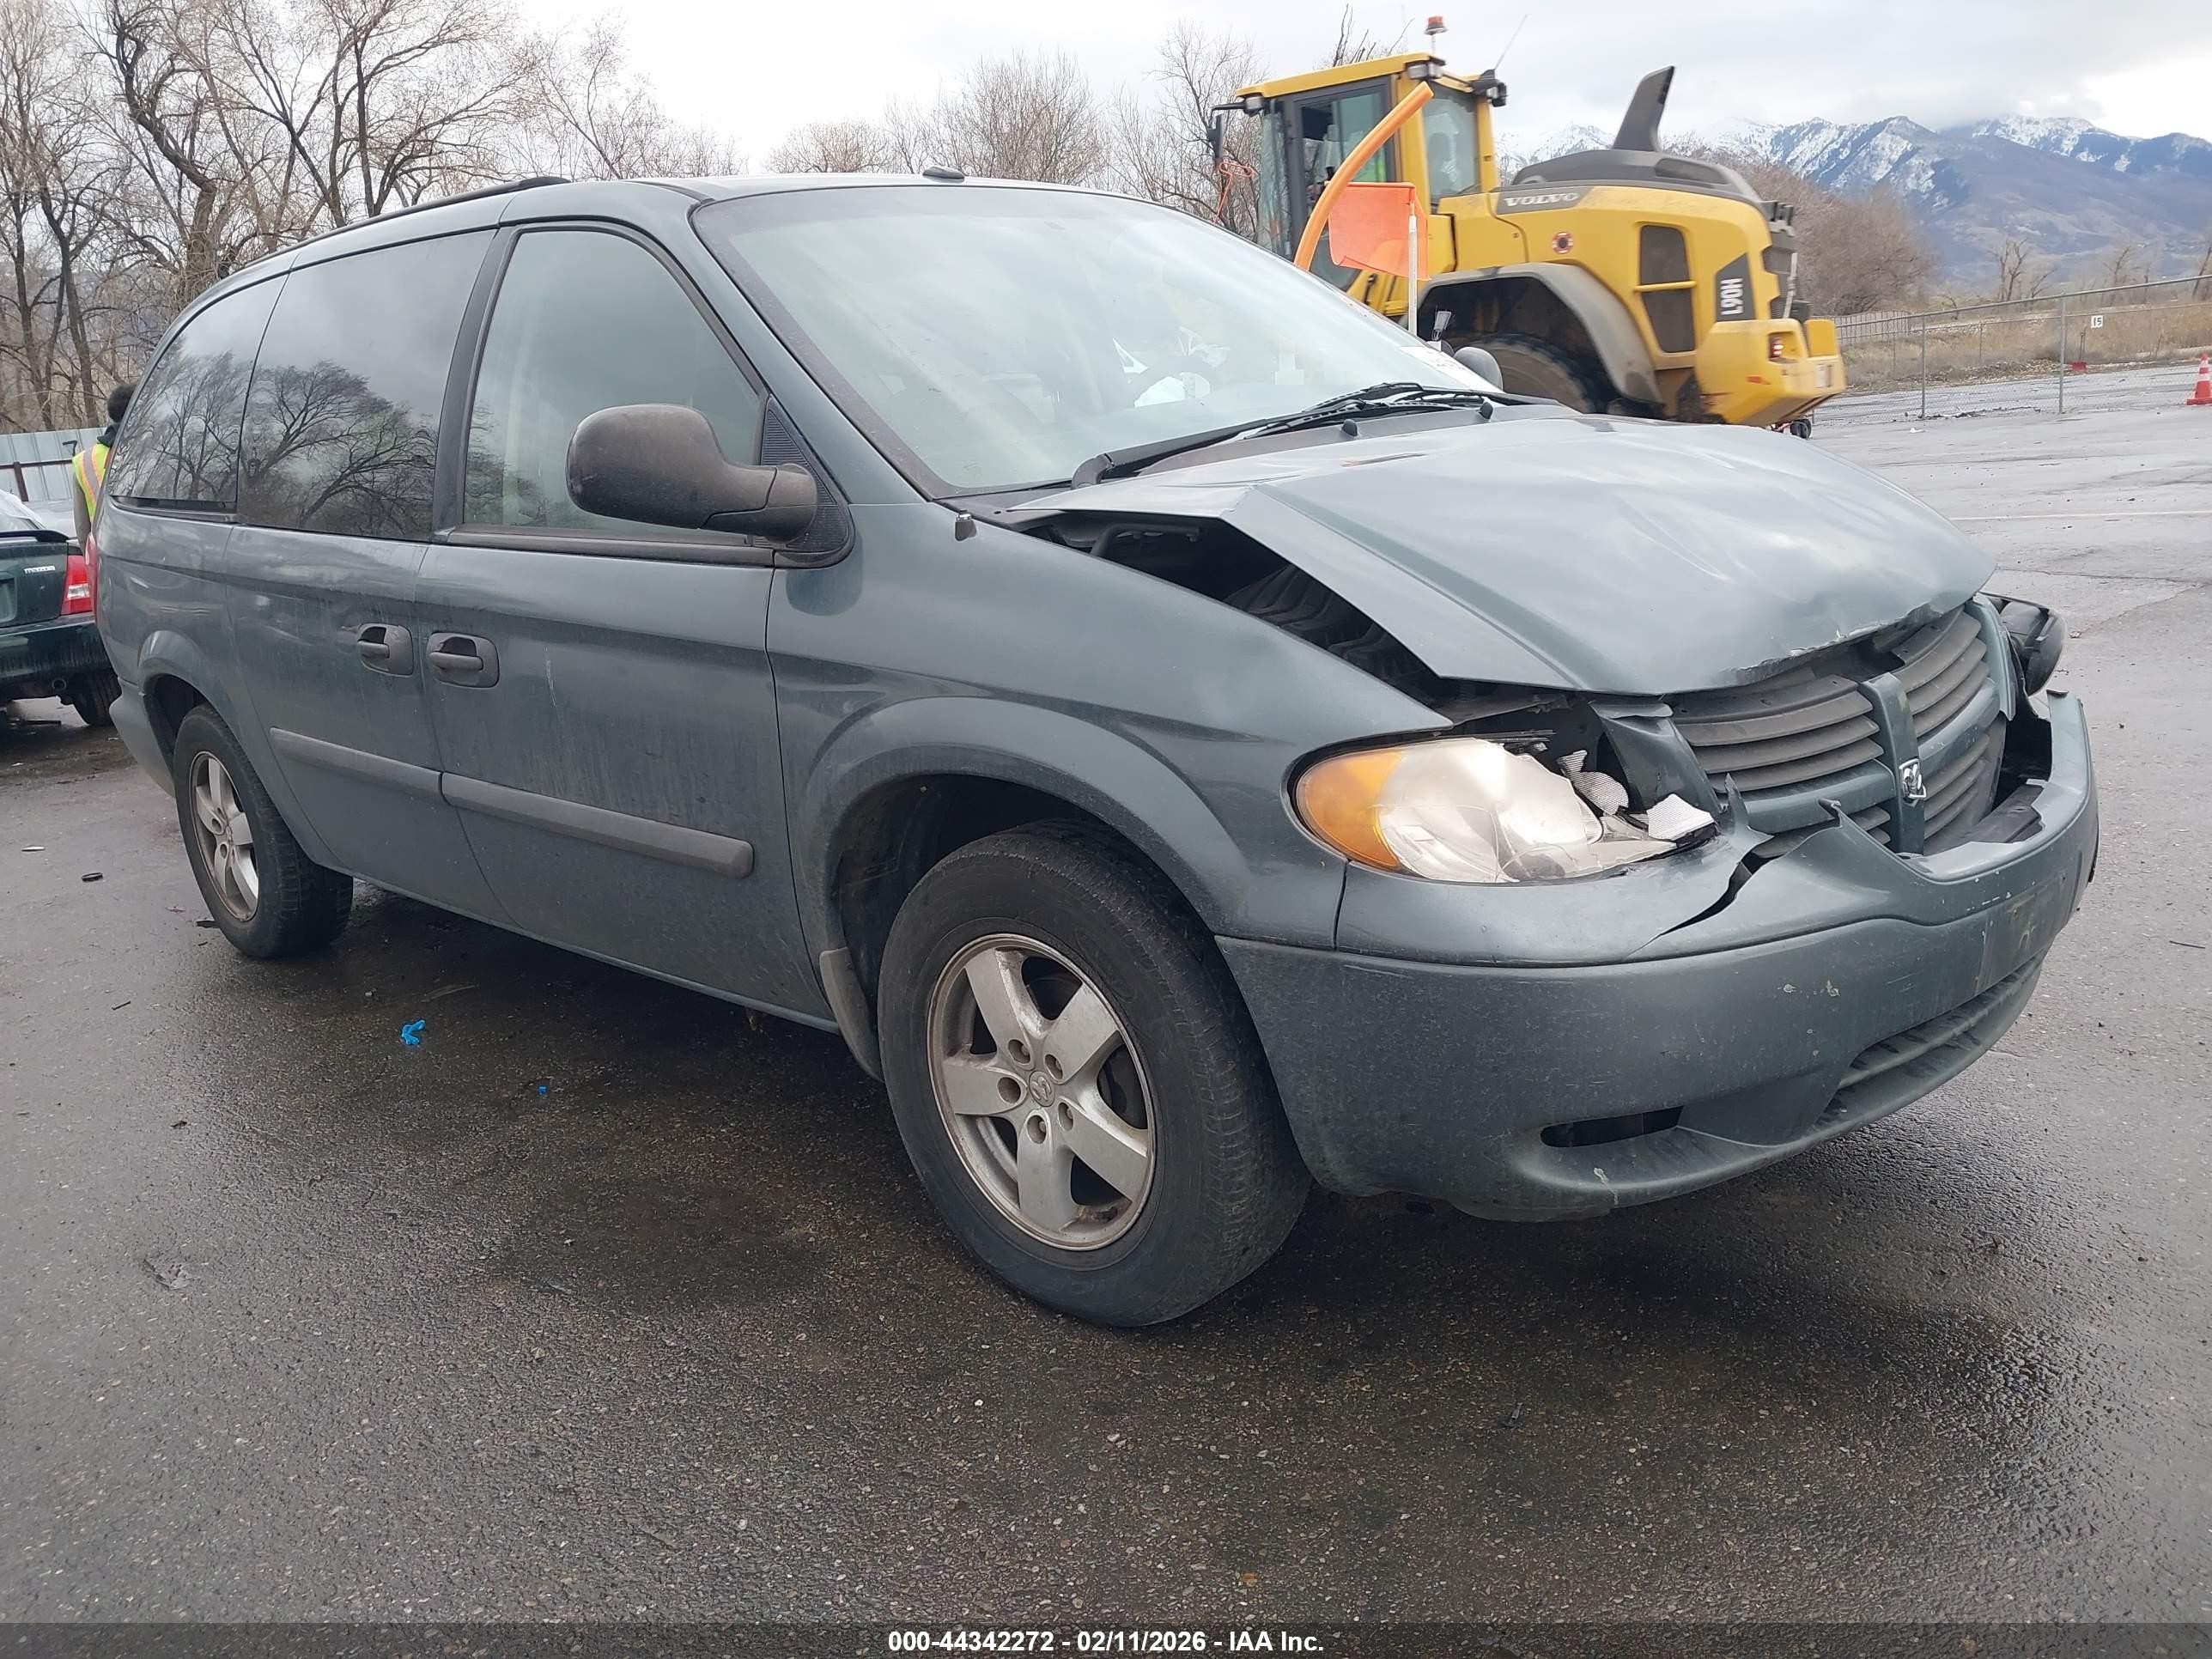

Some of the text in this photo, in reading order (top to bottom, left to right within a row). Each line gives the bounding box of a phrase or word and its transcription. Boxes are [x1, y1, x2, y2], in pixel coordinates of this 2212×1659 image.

[1504, 192, 1579, 206] VOLVO
[1720, 278, 1743, 315] L90H
[2094, 317, 2102, 326] 15
